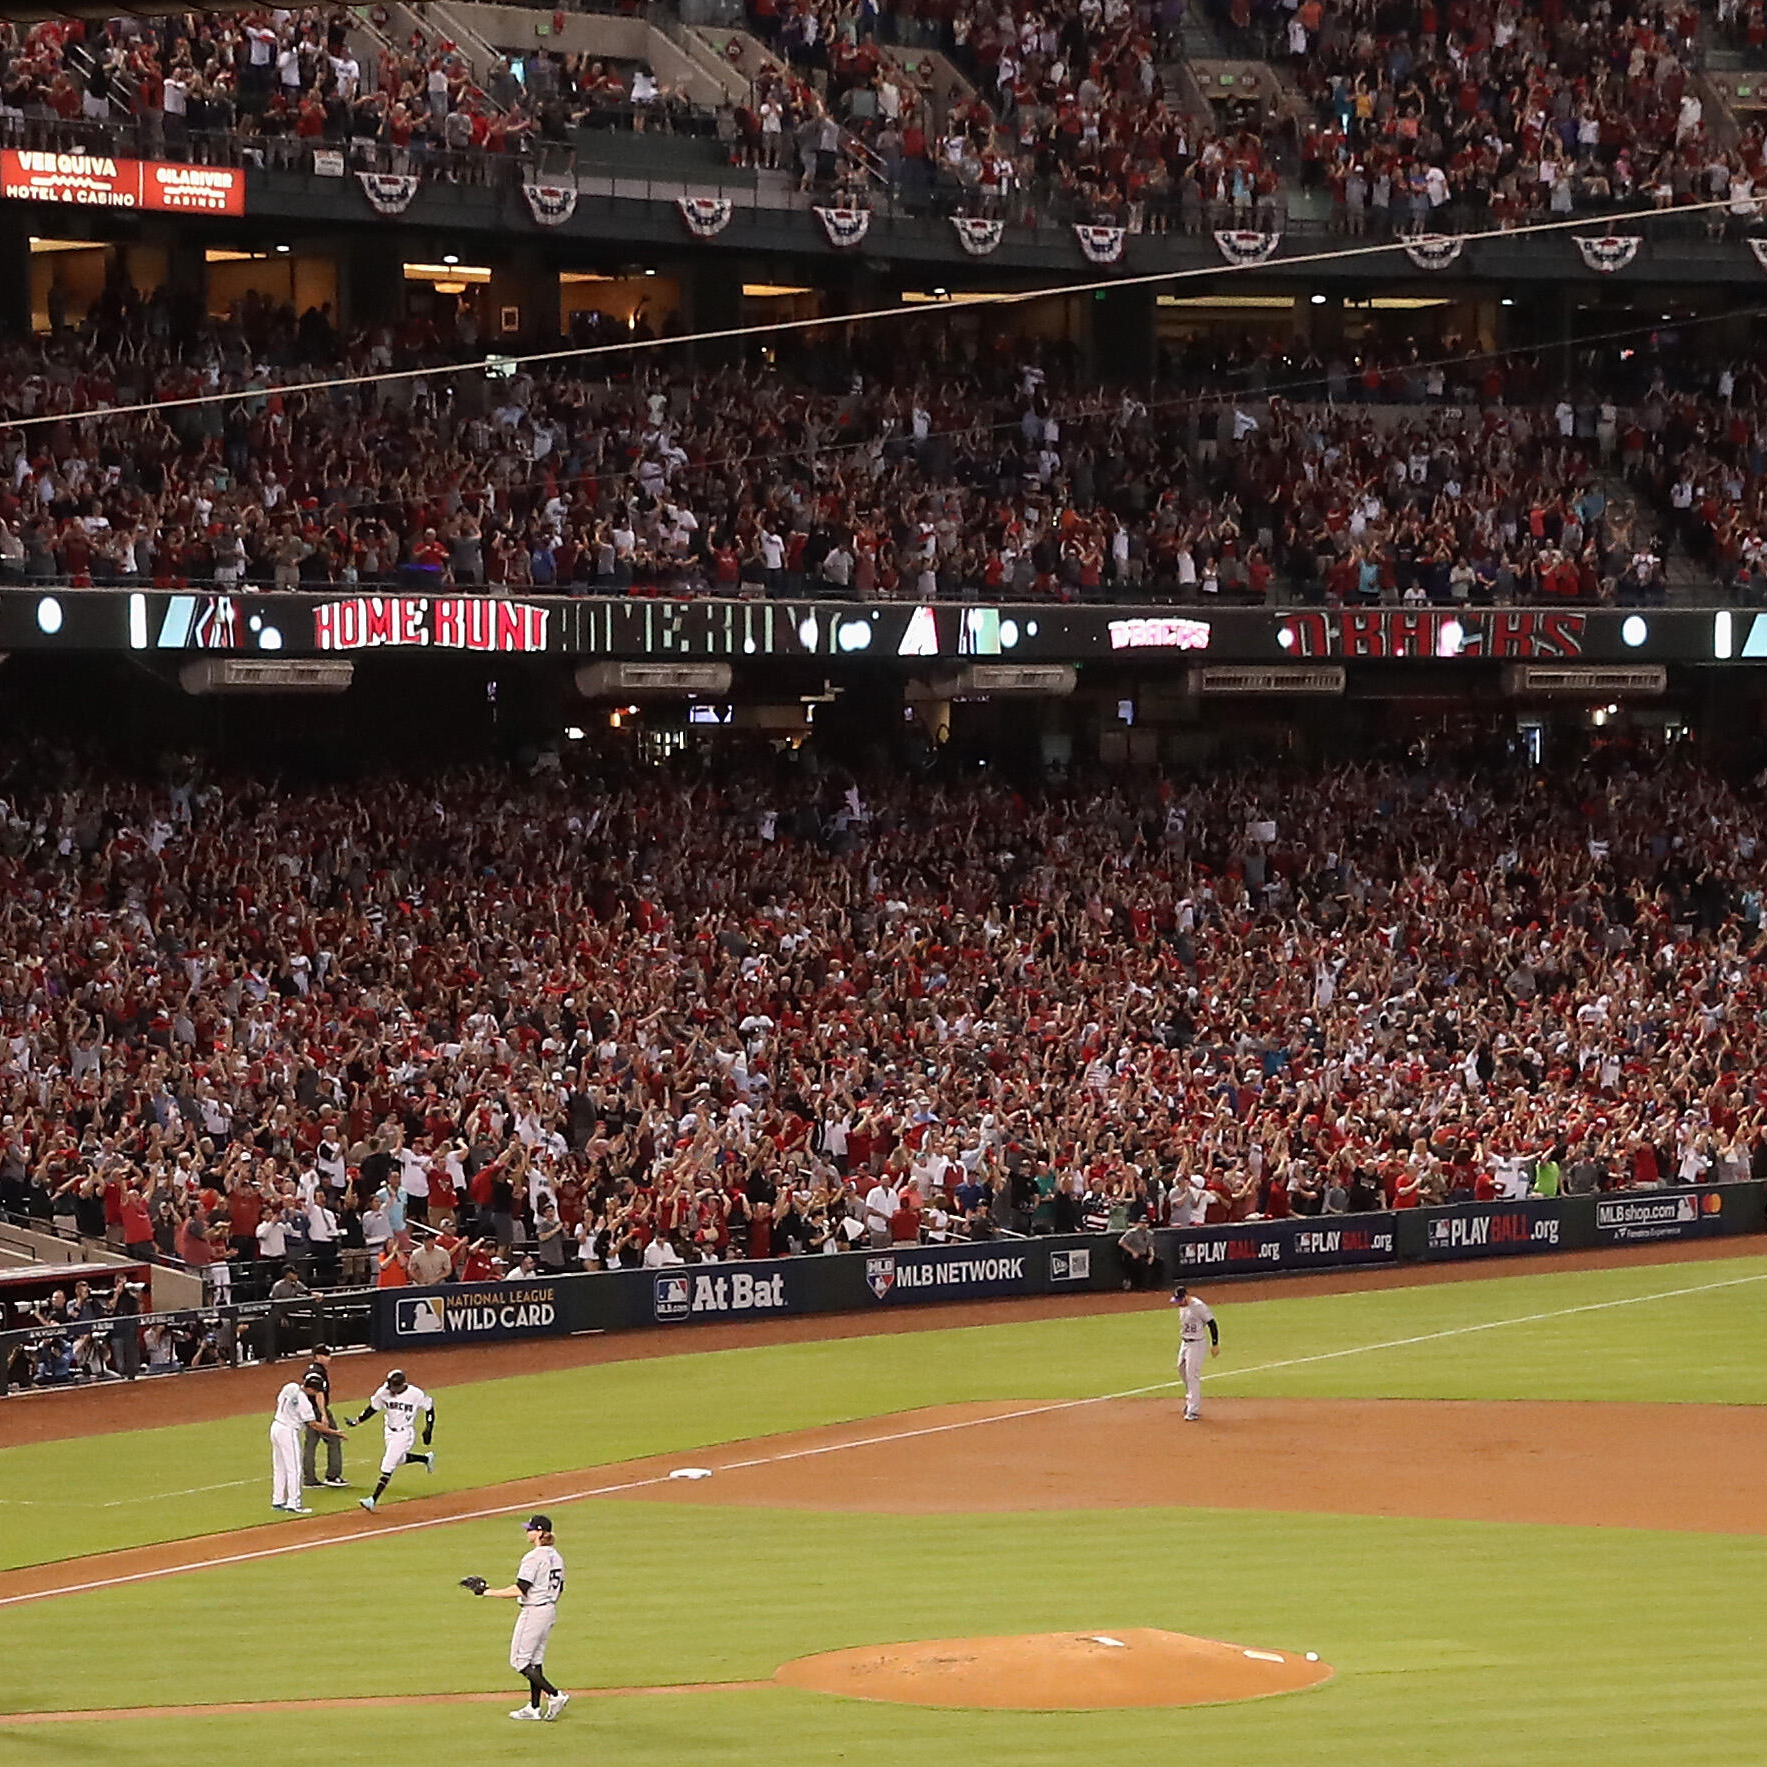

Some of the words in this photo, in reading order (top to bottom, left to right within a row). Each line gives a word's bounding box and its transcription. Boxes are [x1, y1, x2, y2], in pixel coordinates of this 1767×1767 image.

[6, 184, 58, 201] HOTEL
[62, 189, 73, 202] &
[76, 190, 135, 206] CASINO
[163, 194, 226, 208] CASINOS
[313, 598, 429, 648] HOME
[897, 1264, 933, 1288] MLB
[936, 1256, 1026, 1285] NETWORK
[446, 1292, 506, 1308] NATIONAL
[510, 1288, 555, 1304] LEAGUE
[692, 1275, 729, 1312] At
[732, 1273, 785, 1310] Bat
[446, 1308, 497, 1332] WILD
[500, 1303, 556, 1329] CARD
